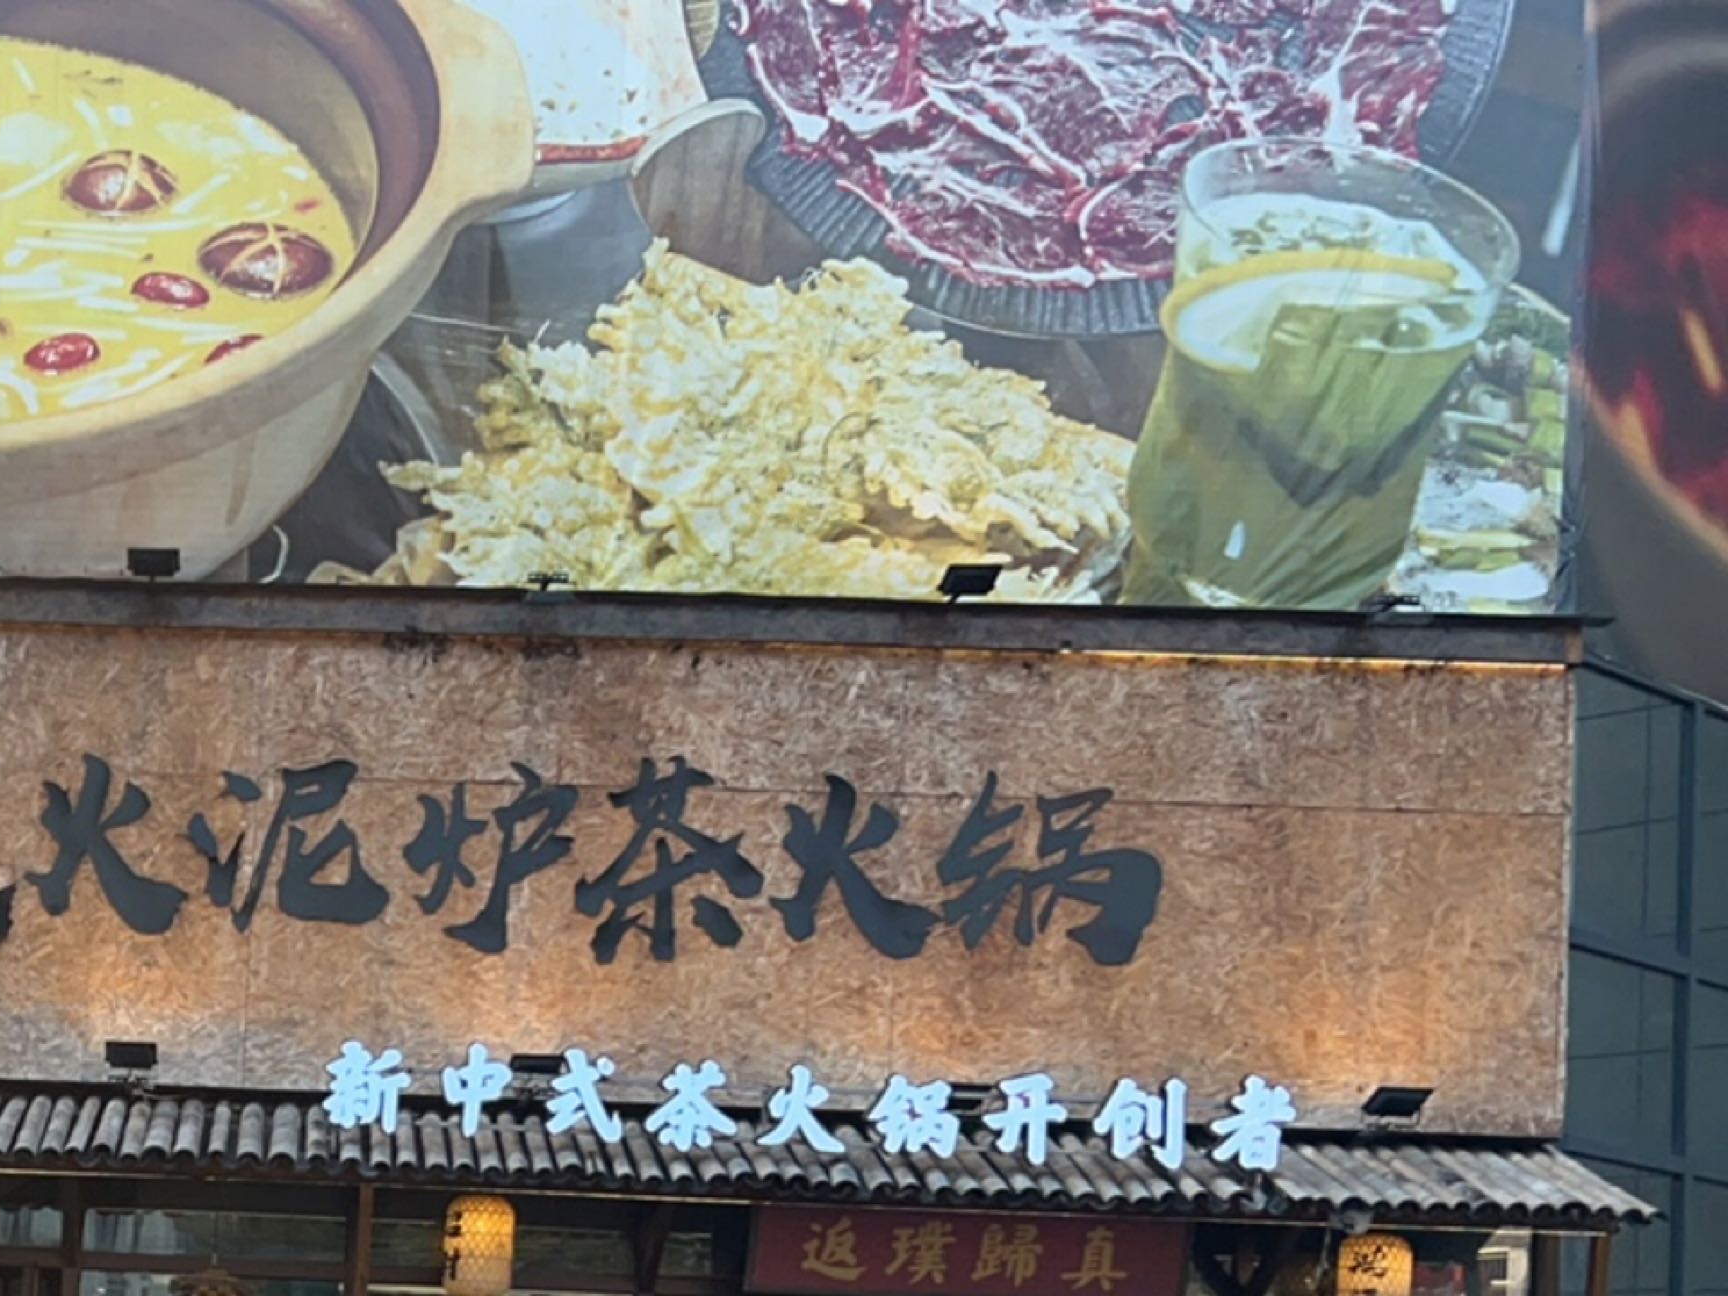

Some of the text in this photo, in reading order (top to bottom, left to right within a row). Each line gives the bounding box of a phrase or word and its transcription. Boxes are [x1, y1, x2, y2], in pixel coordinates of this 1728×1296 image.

[324, 1040, 1294, 1172] 新中式茶火锅开创者
[801, 1219, 1125, 1292] 返璞歸真
